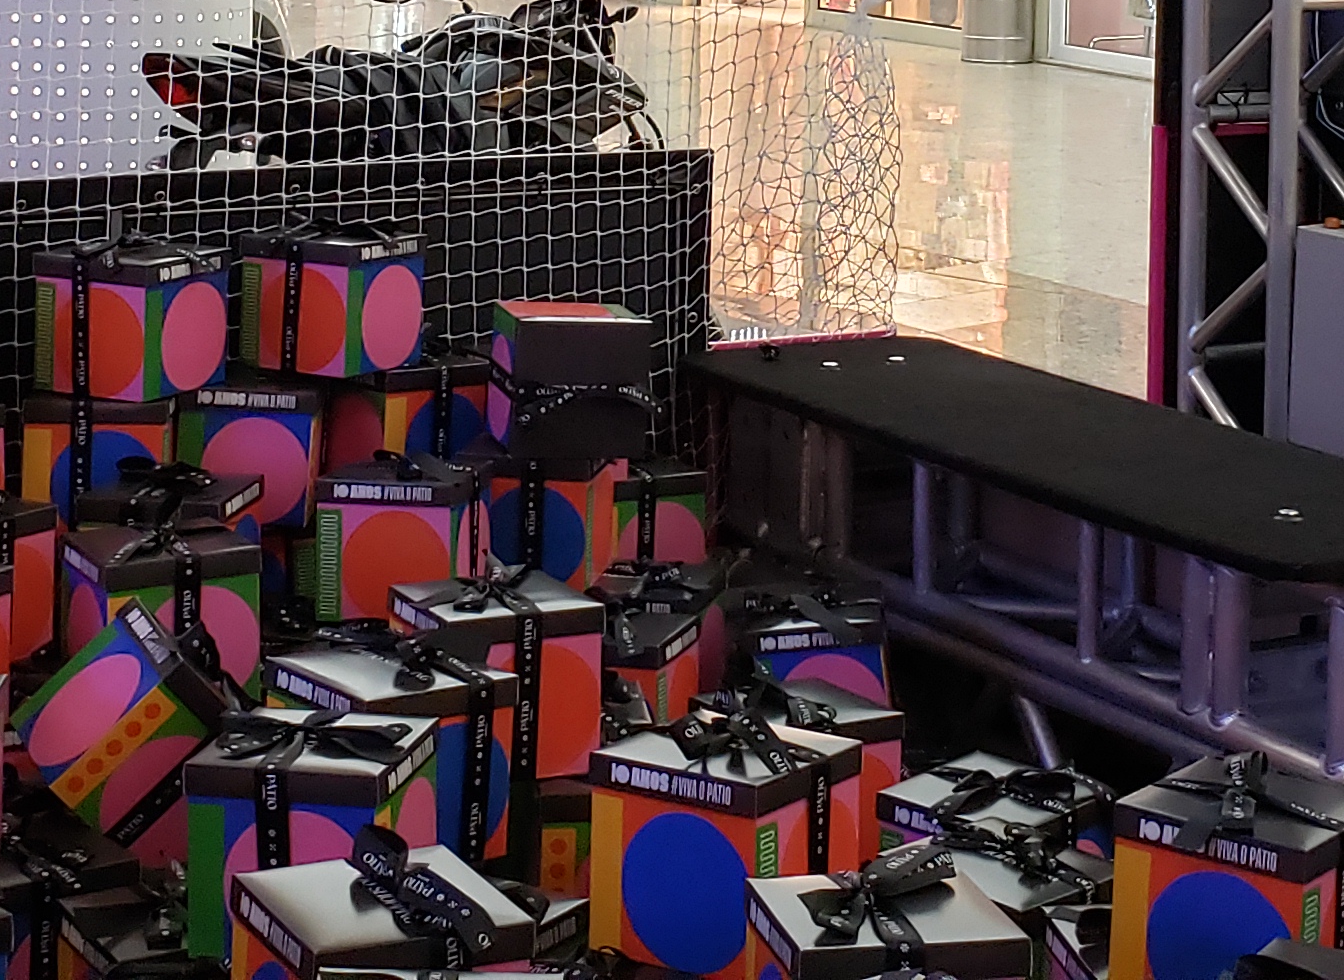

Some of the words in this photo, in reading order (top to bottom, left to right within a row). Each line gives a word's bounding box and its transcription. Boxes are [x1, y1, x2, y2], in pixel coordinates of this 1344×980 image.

[760, 636, 777, 650] 10
[778, 634, 810, 651] ANOS
[611, 762, 630, 784] 10
[630, 766, 670, 794] ANOS
[671, 775, 698, 799] #VIVA
[698, 782, 705, 800] O
[706, 780, 732, 806] PÁTIO
[894, 804, 910, 824] 10
[1139, 820, 1161, 841] 10
[1208, 836, 1239, 862] #VIVA
[1240, 847, 1247, 863] O
